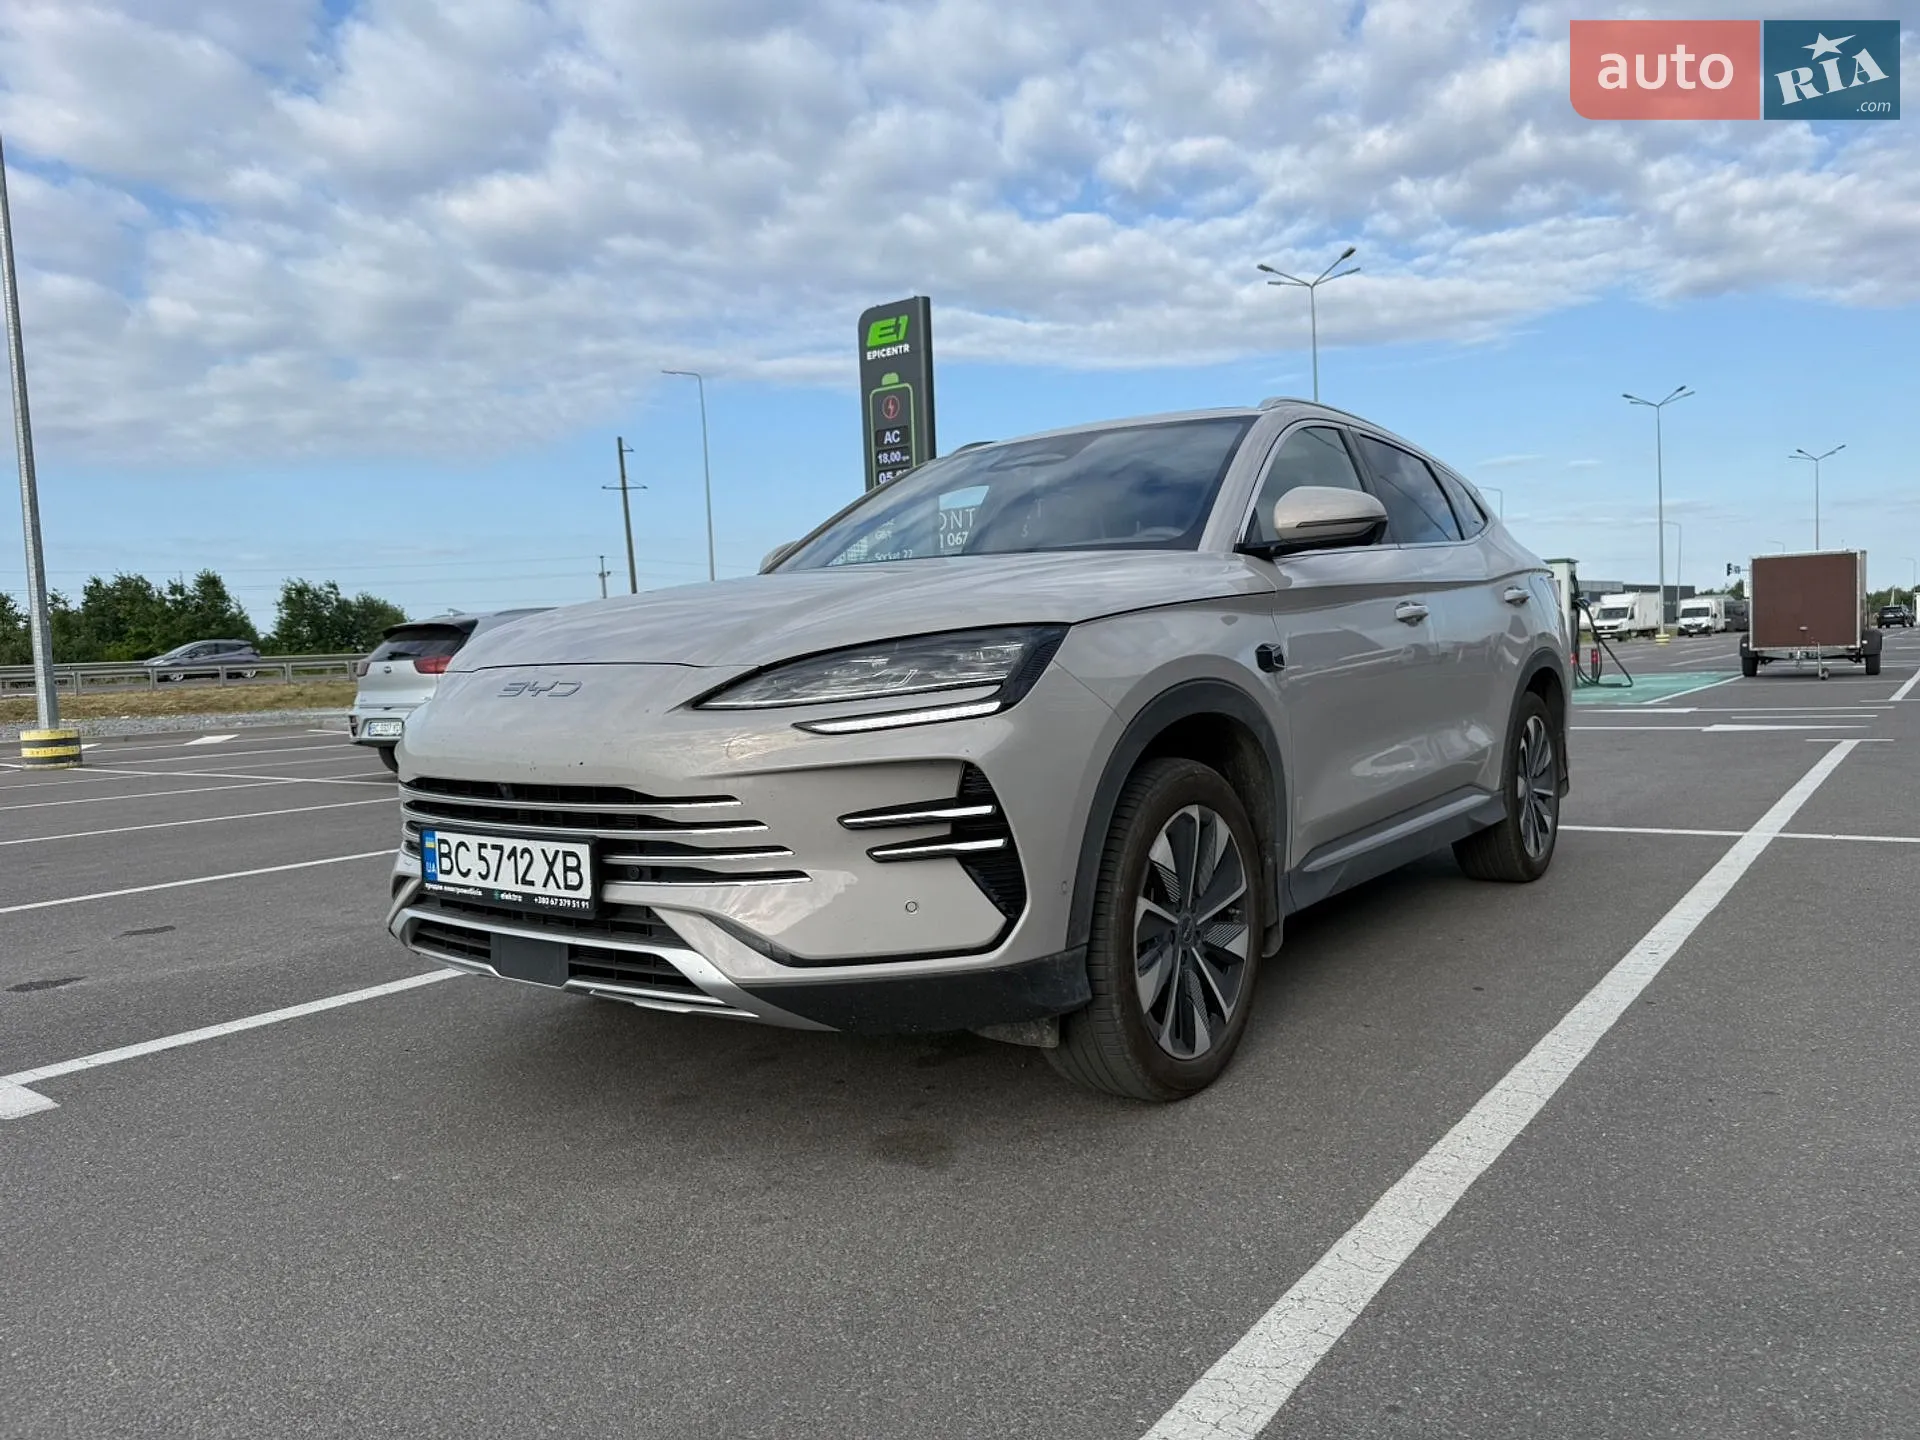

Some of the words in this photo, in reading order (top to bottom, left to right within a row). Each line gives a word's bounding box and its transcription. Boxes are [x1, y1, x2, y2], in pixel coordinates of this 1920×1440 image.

[866, 343, 910, 361] EPICENTR
[883, 430, 901, 445] AC
[497, 680, 583, 697] BYD
[425, 861, 437, 873] UA
[437, 838, 472, 878] BC
[476, 842, 535, 887] 5712
[541, 848, 584, 891] XB
